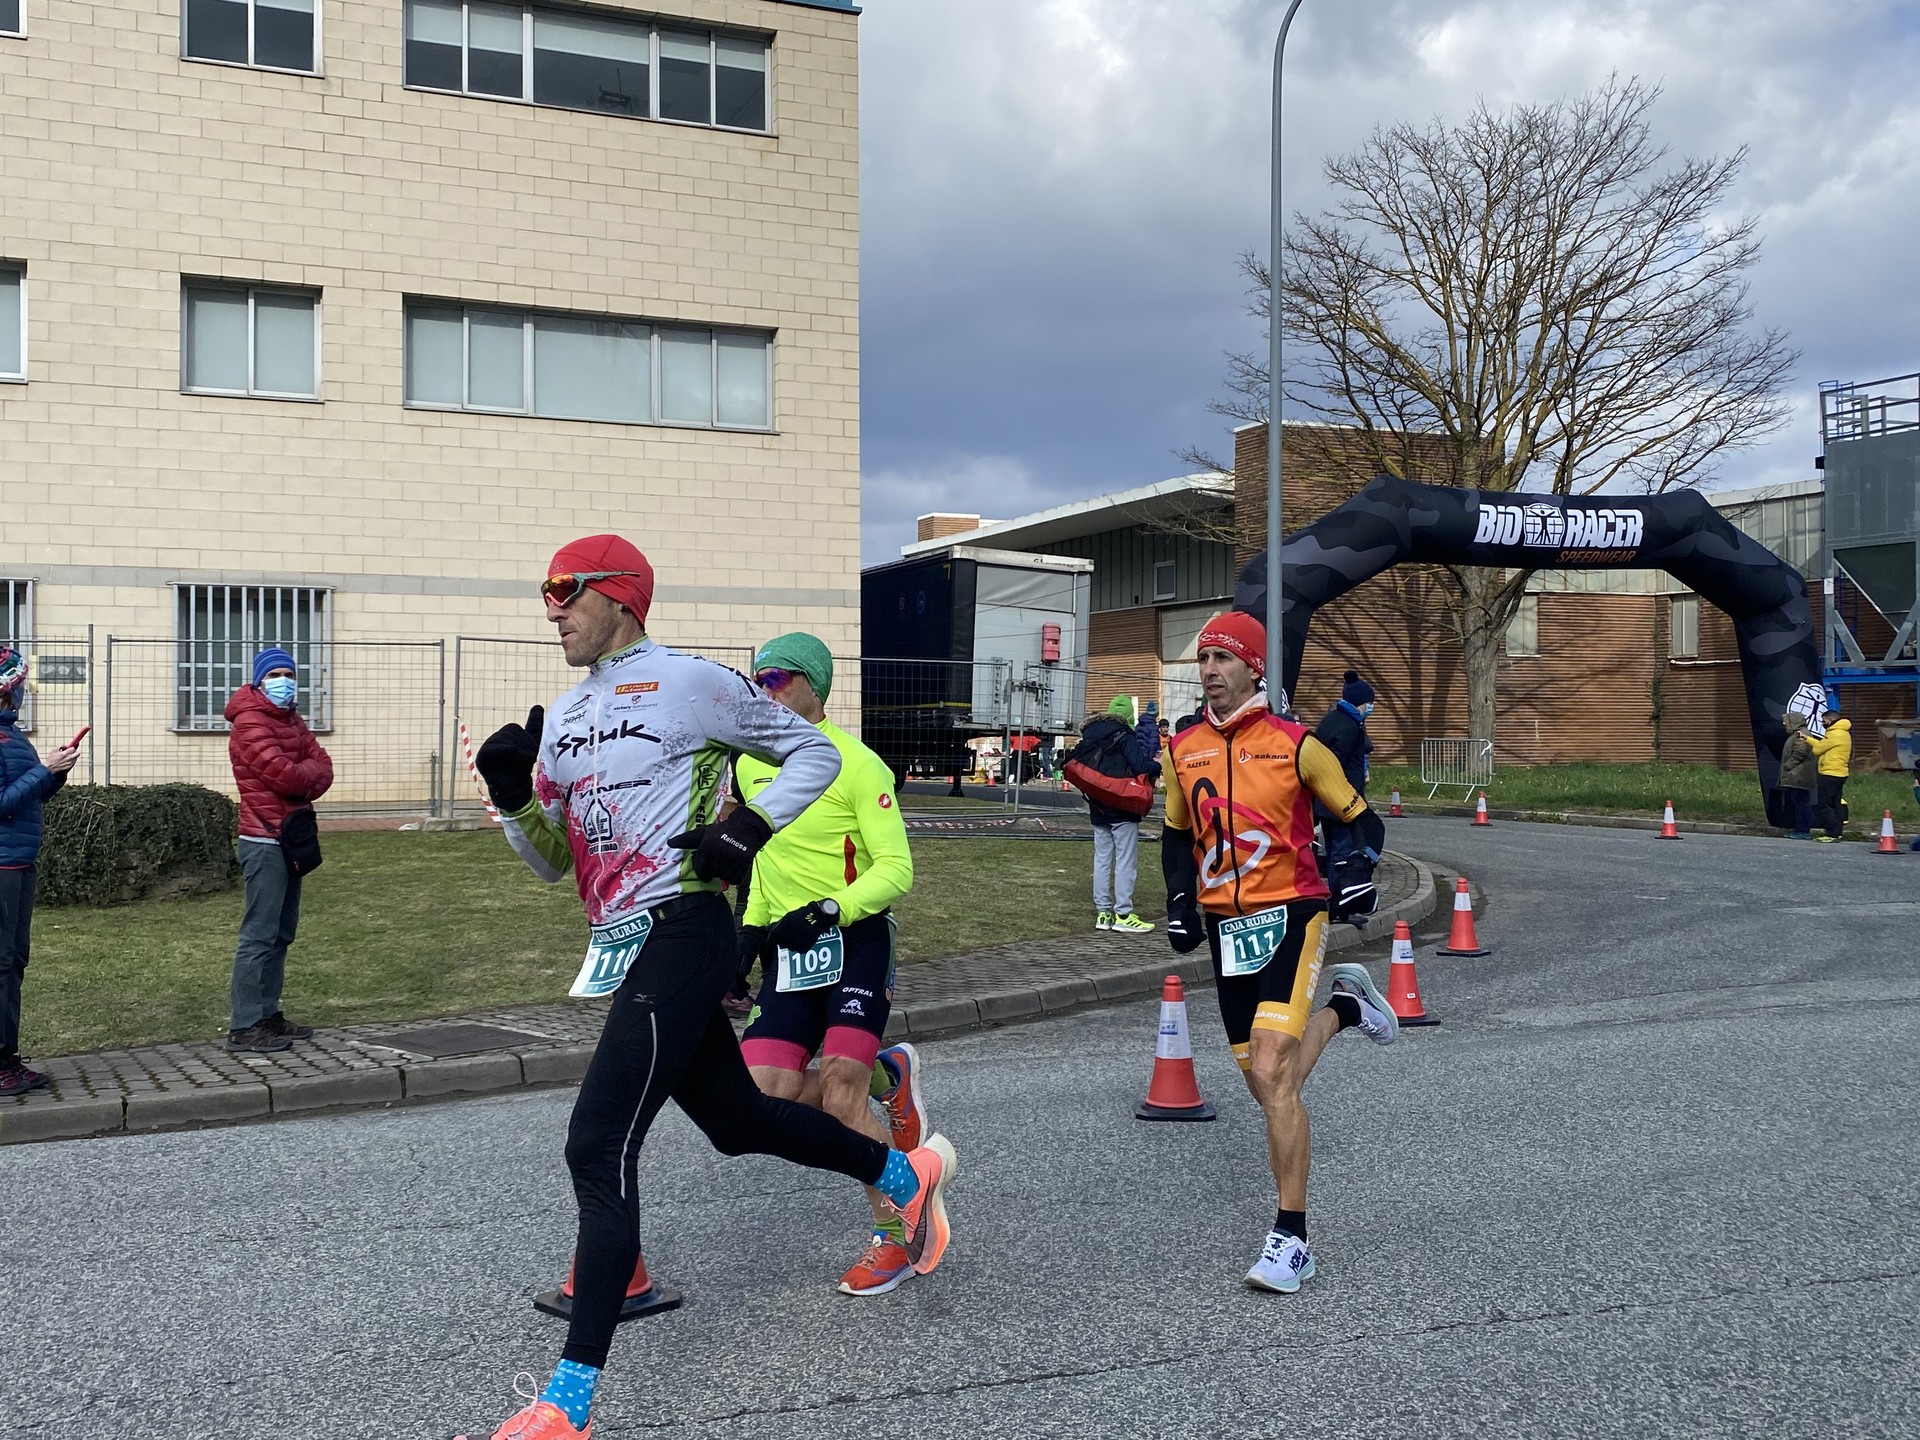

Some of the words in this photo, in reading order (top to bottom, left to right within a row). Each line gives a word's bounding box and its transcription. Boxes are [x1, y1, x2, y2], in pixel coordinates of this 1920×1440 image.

[1562, 508, 1644, 548] RACER
[1555, 550, 1637, 564] SPEEDWEAR
[1186, 760, 1212, 769] RAZESA
[720, 833, 748, 852] Reinosa
[610, 919, 648, 940] RURAL
[1246, 911, 1282, 928] RURAL
[1235, 930, 1274, 959] 111
[598, 943, 639, 978] 110
[792, 946, 832, 975] 109
[842, 986, 873, 997] OPTRAL
